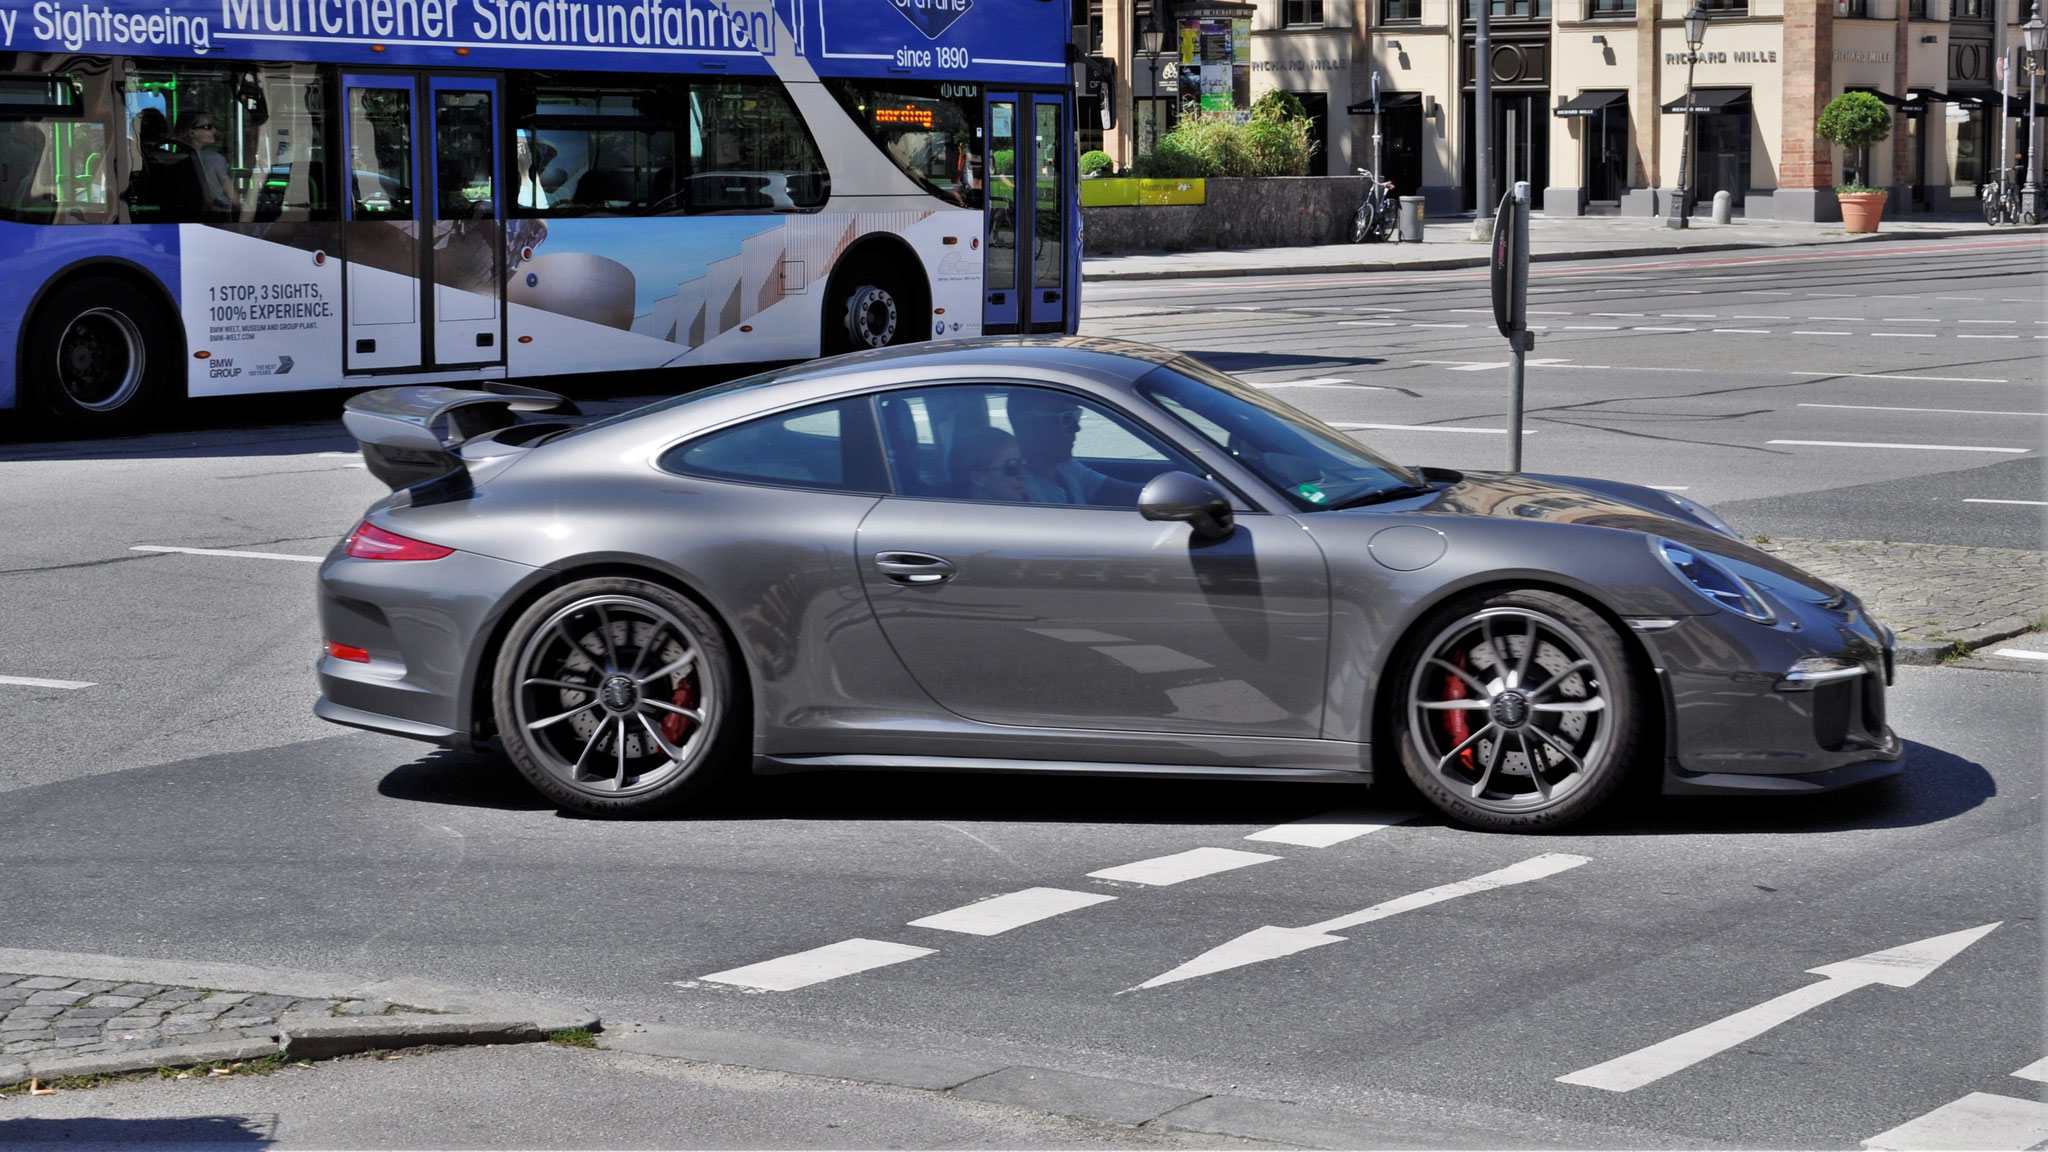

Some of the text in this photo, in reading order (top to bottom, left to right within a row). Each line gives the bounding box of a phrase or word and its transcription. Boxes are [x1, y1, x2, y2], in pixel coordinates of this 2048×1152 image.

[33, 1, 209, 54] Sightseeing
[473, 0, 769, 48] Stadtrundfahrten
[896, 45, 968, 69] since 1890
[1665, 51, 1777, 65] RICARD MILLE
[1833, 51, 1866, 62] RICHARD
[1252, 59, 1347, 71] RICHARD MILLE
[209, 283, 322, 303] 1 STOP, 3 SIGHTS,
[209, 302, 333, 321] 100% EXPERIENCE.
[242, 324, 266, 332] MUSEUM
[267, 323, 278, 331] AND
[280, 322, 298, 330] GROUP
[210, 358, 233, 368] BMW
[210, 368, 242, 378] GROUP
